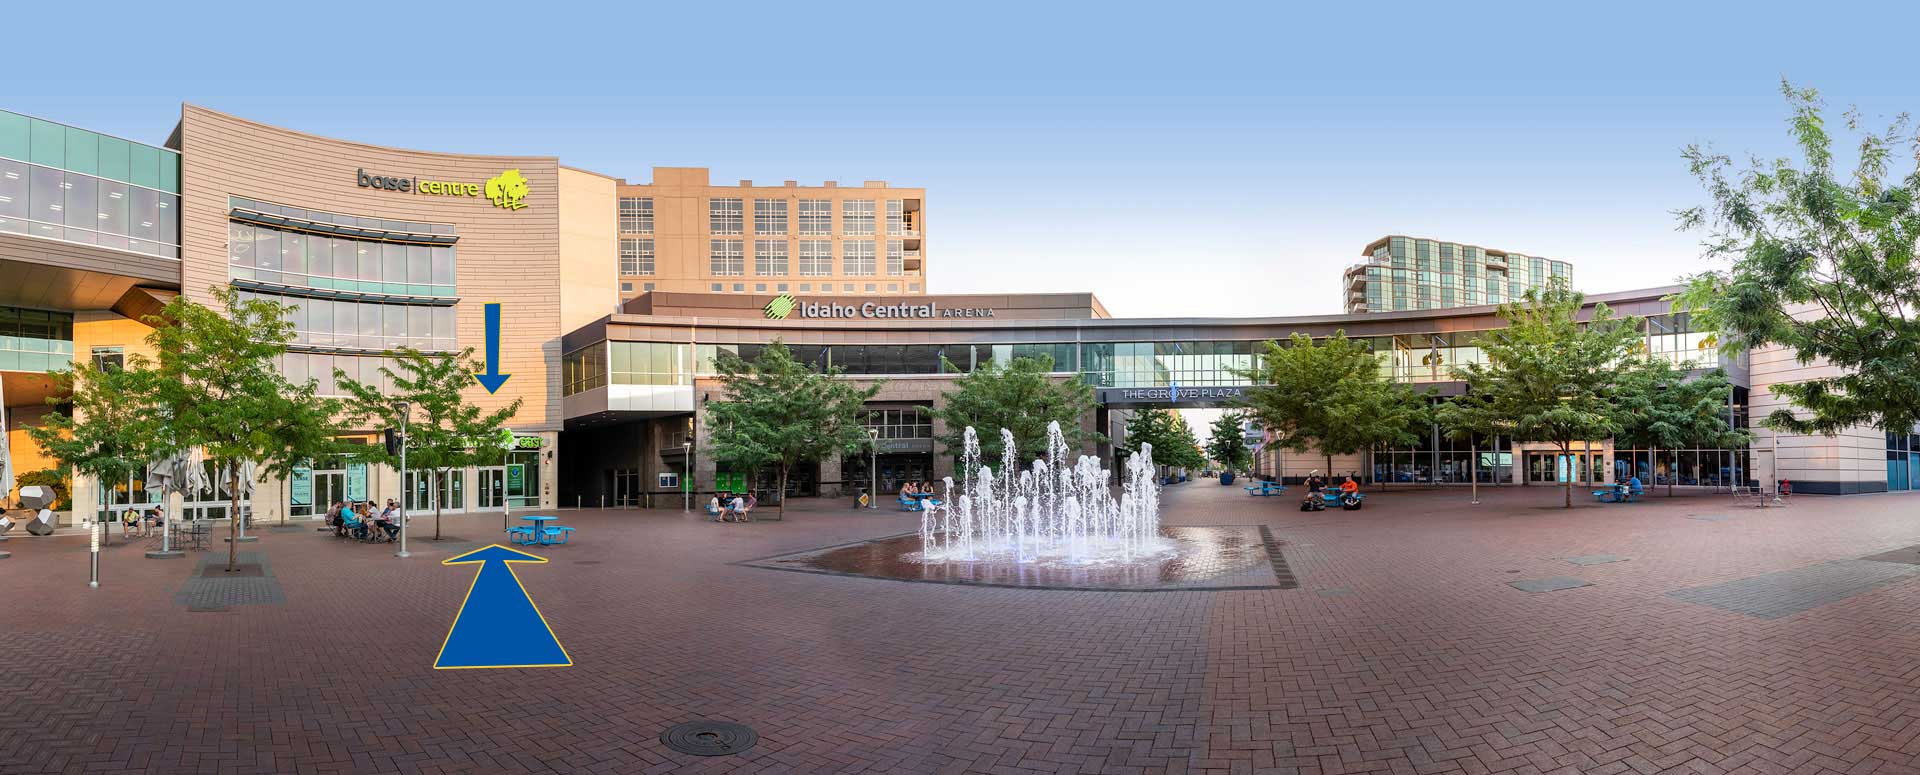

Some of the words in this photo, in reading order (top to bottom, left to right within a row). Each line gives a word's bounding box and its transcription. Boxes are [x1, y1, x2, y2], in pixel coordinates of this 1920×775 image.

[357, 168, 411, 192] boise
[419, 180, 479, 197] centre
[800, 301, 857, 319] Idaho
[861, 301, 936, 319] Central
[943, 307, 995, 318] ARENA
[1122, 389, 1145, 399] THE
[1147, 389, 1199, 399] GROVE
[1201, 388, 1241, 398] PLAZA
[519, 436, 543, 448] east
